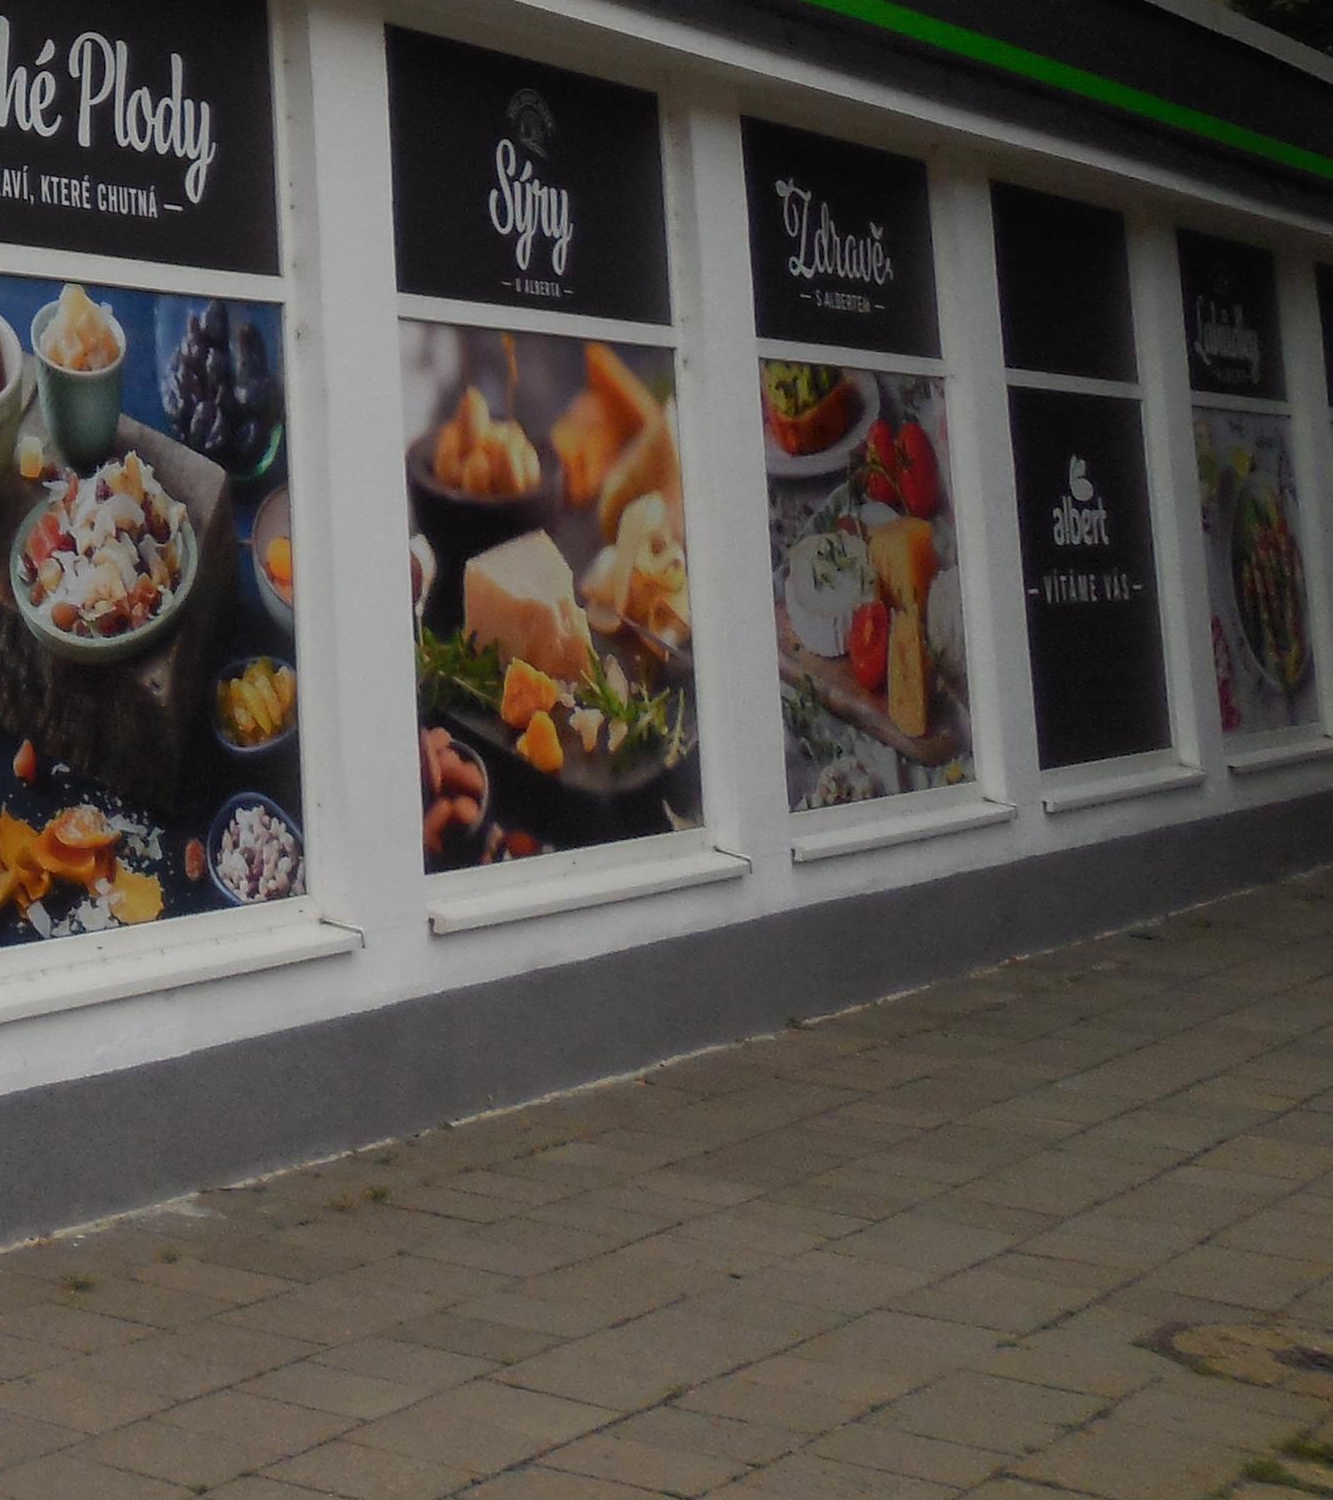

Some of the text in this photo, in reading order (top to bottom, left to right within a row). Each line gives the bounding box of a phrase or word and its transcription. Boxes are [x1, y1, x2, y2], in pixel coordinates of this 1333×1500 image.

[68, 31, 216, 203] Plody
[41, 175, 92, 210] KTERÉ
[97, 183, 158, 219] CHUTNÁ
[490, 138, 574, 276] Sýry
[775, 177, 894, 285] Zdravě
[1052, 495, 1109, 546] albert
[1043, 566, 1130, 604] VÍTÁME VÁS
